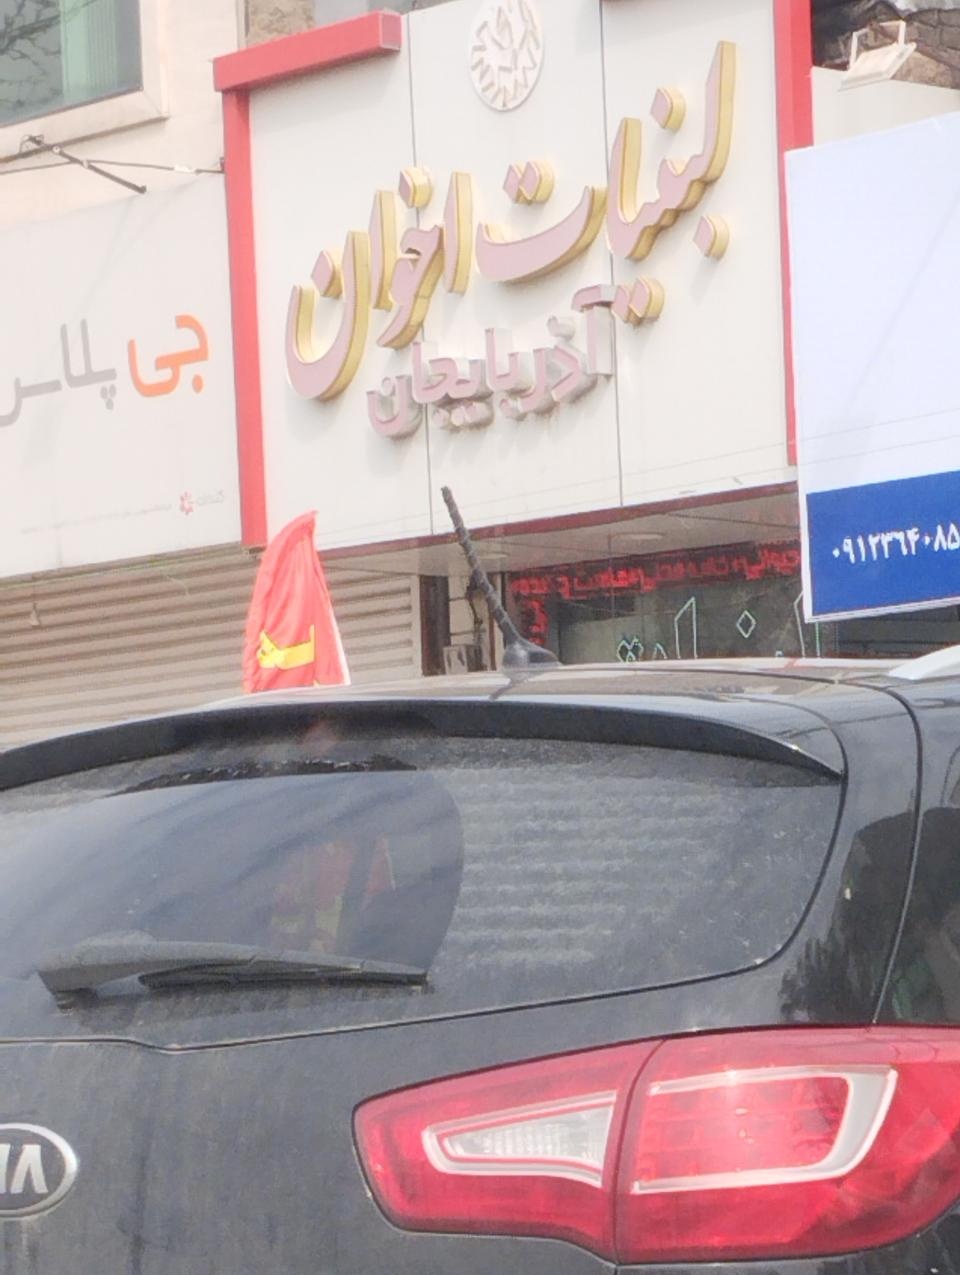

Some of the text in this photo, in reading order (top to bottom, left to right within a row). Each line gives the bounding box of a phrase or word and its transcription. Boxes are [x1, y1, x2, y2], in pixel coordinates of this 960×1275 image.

[284, 40, 737, 401] لبنیات اخوان
[127, 314, 209, 398] جی
[366, 284, 614, 438] آذربایجان
